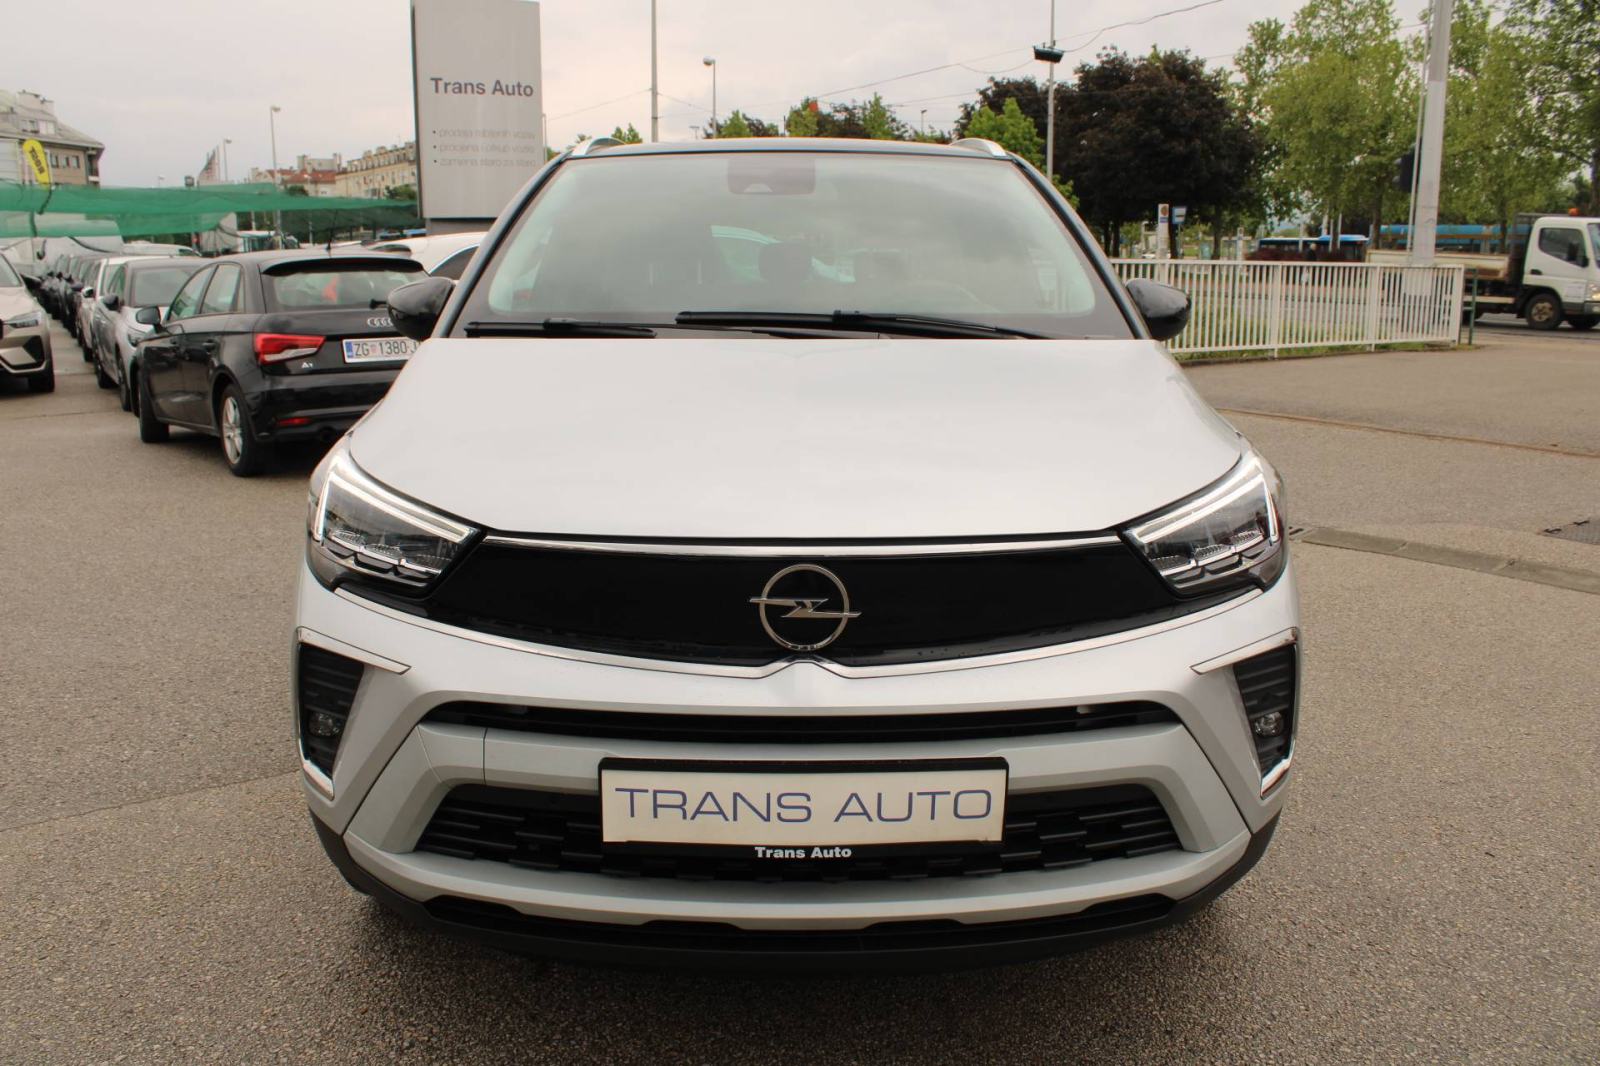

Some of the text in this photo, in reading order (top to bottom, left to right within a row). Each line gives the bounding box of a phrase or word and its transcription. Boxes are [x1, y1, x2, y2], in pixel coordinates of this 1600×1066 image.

[430, 77, 534, 97] Trans Auto
[353, 342, 370, 356] ZG
[615, 787, 992, 823] TRANS AUTO
[754, 846, 852, 858] Trans Auto
